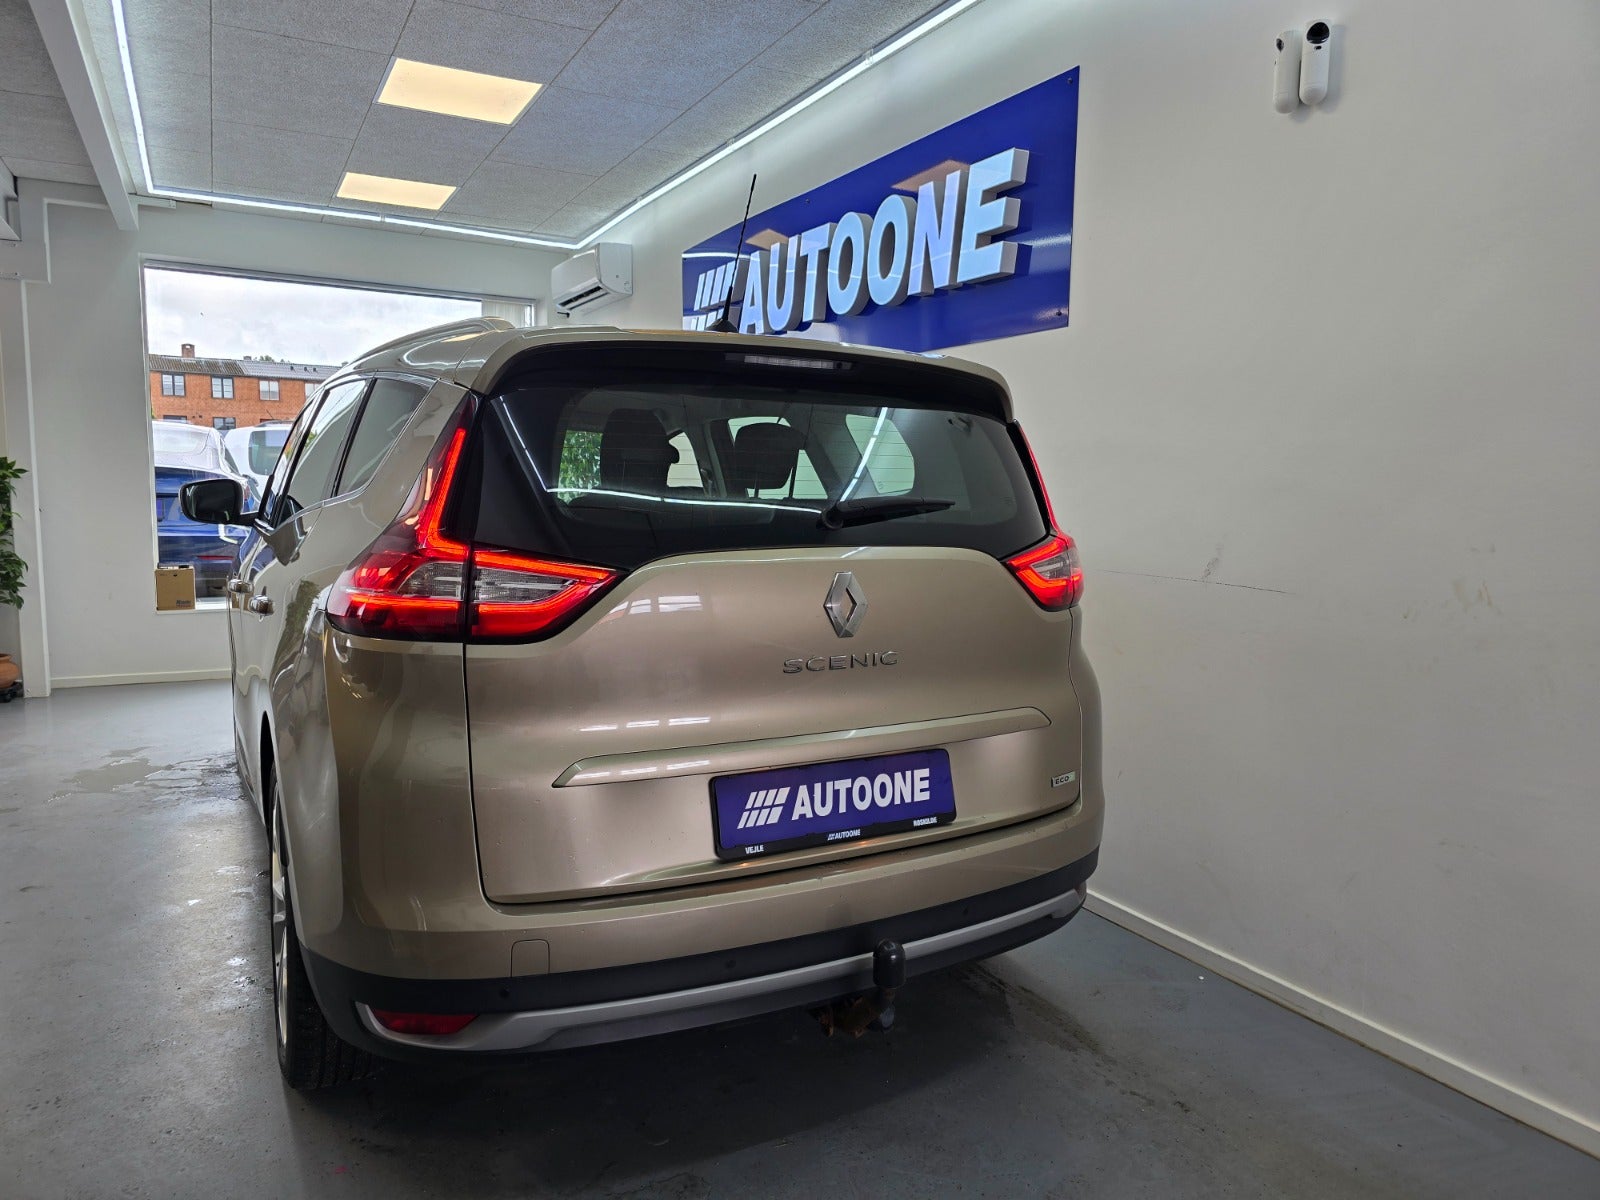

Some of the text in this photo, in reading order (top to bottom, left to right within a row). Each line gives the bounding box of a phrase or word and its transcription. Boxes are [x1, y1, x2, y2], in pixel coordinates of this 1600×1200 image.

[739, 147, 1027, 335] AUTOONE
[782, 650, 899, 674] SCENIC
[1055, 775, 1070, 785] ECO
[791, 767, 931, 821] AUTOONE
[834, 829, 861, 840] AUTOONE
[745, 844, 765, 855] VEJLE
